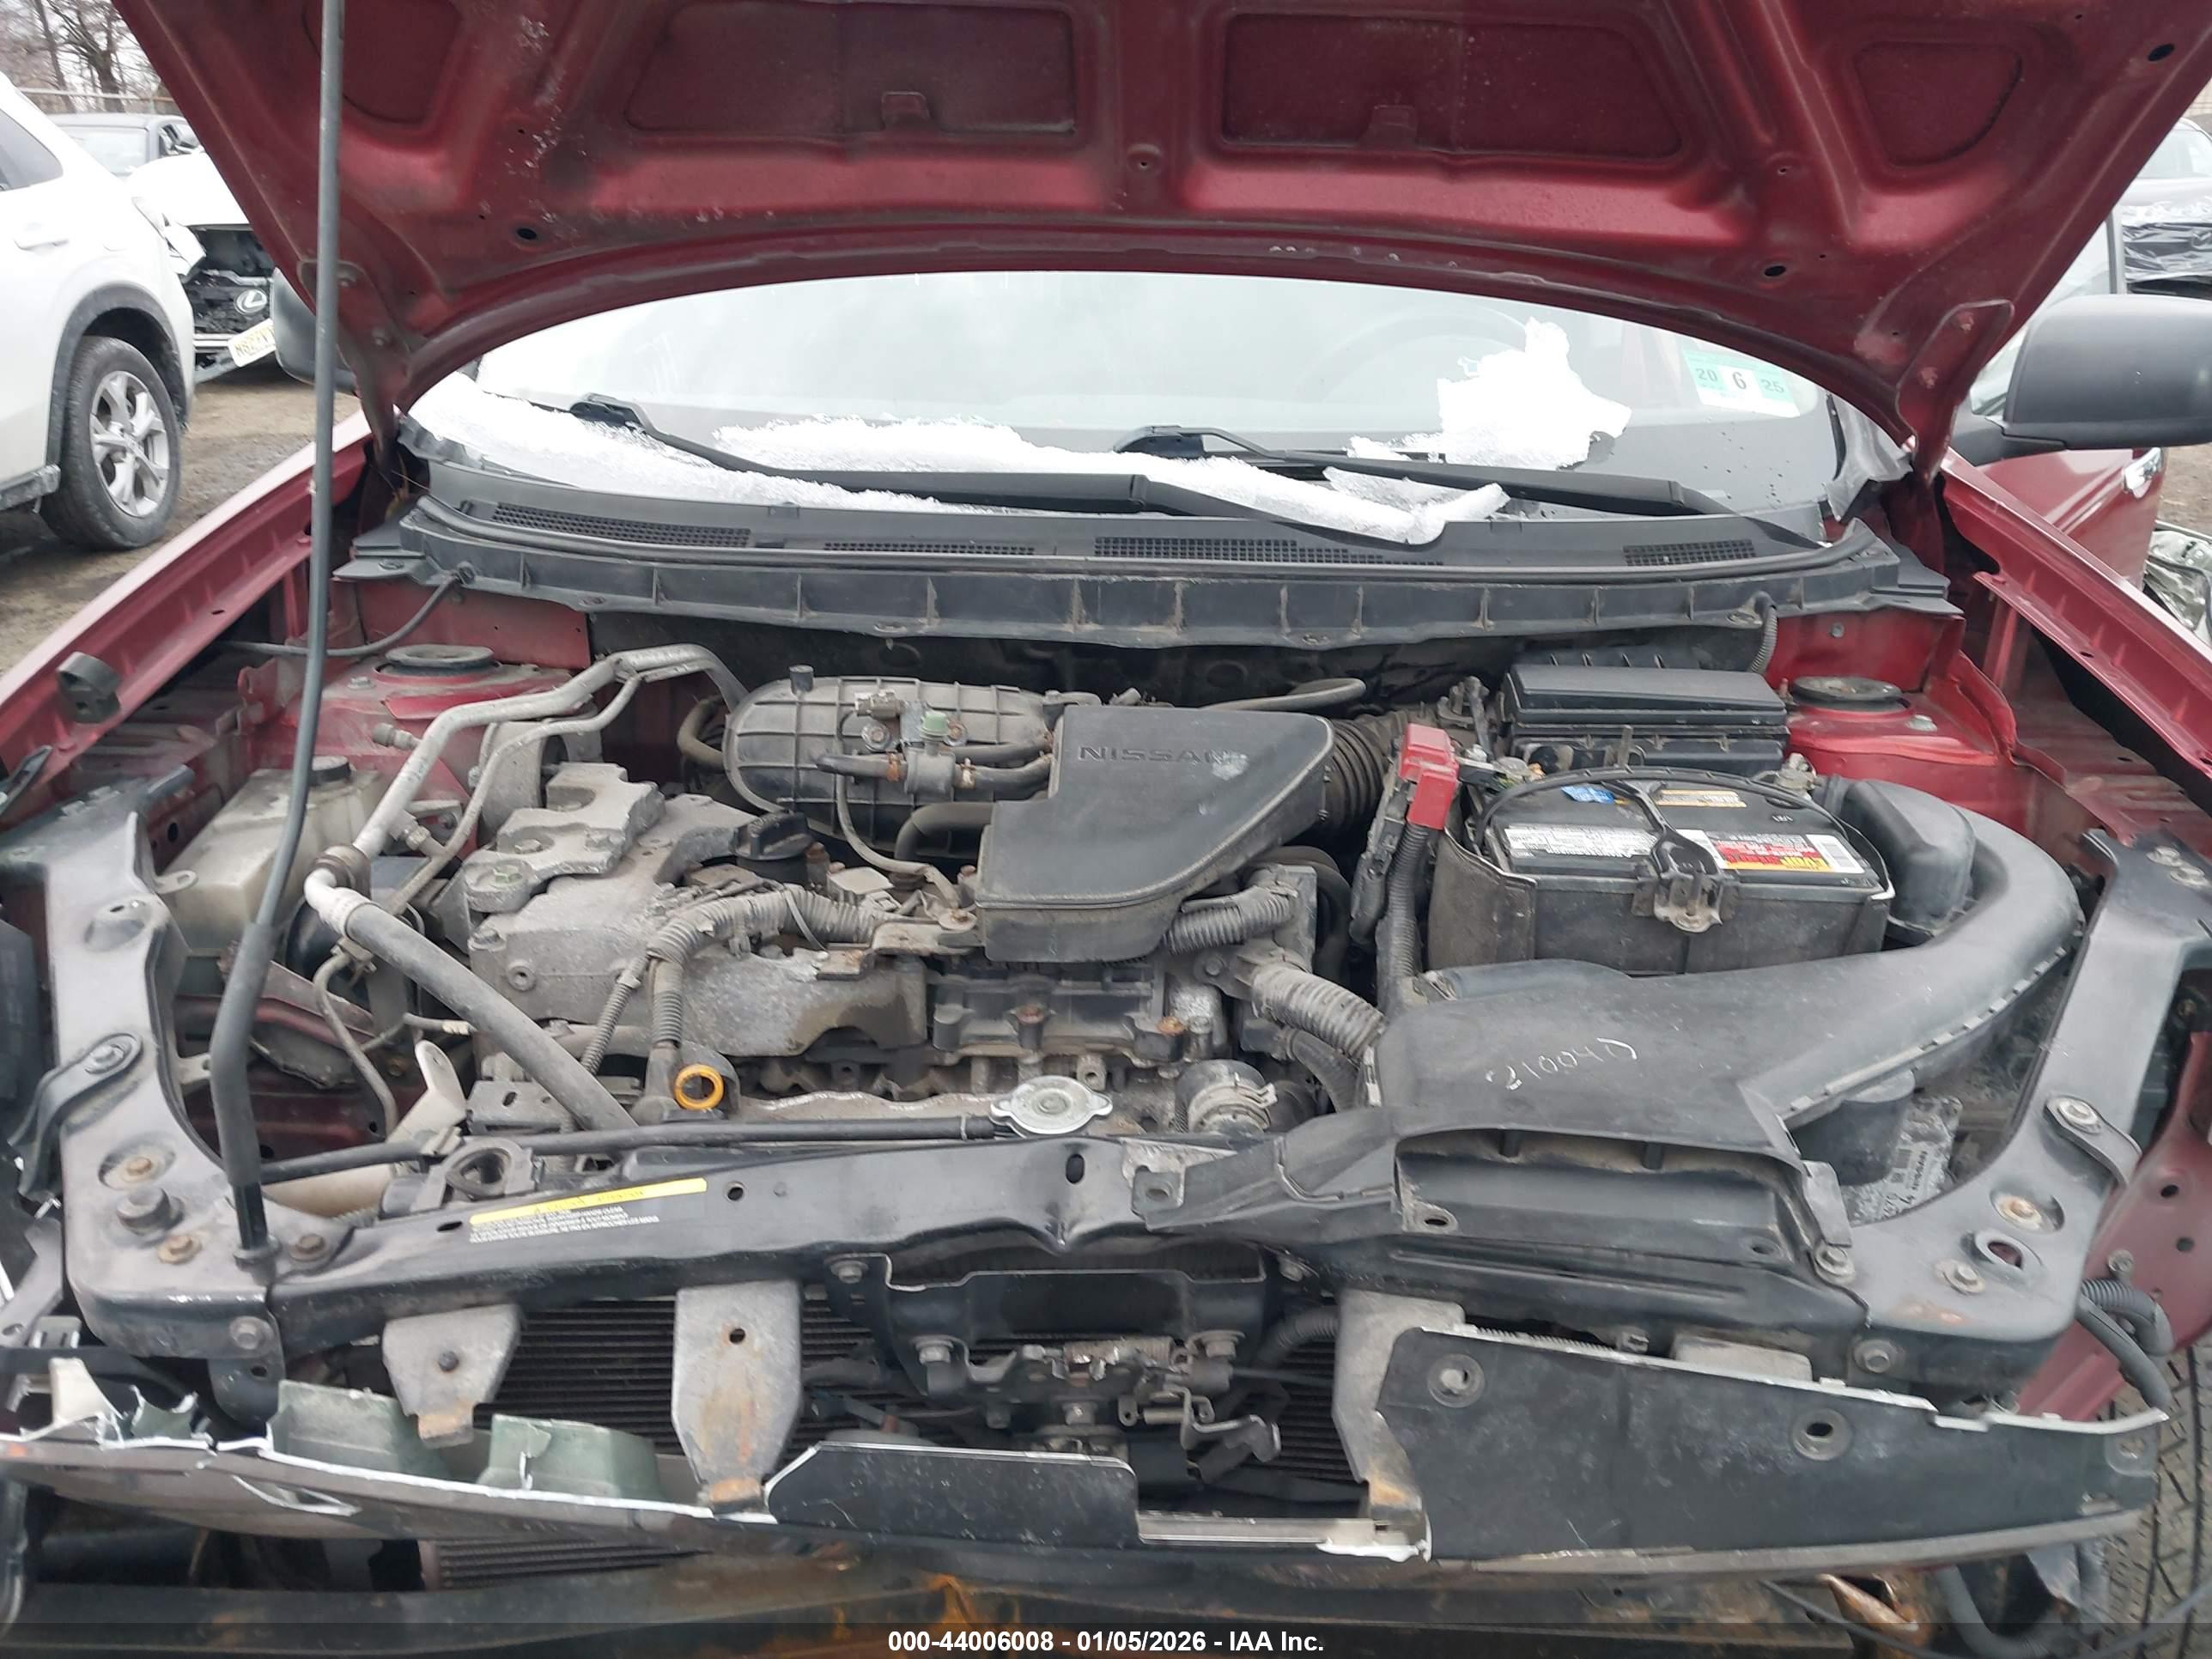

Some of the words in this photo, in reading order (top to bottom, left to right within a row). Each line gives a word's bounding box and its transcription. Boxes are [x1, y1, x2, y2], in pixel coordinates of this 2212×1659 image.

[1695, 368, 1718, 382] 20
[1731, 371, 1747, 390] 6
[1760, 379, 1785, 393] 25
[1079, 745, 1233, 765] NISSAN
